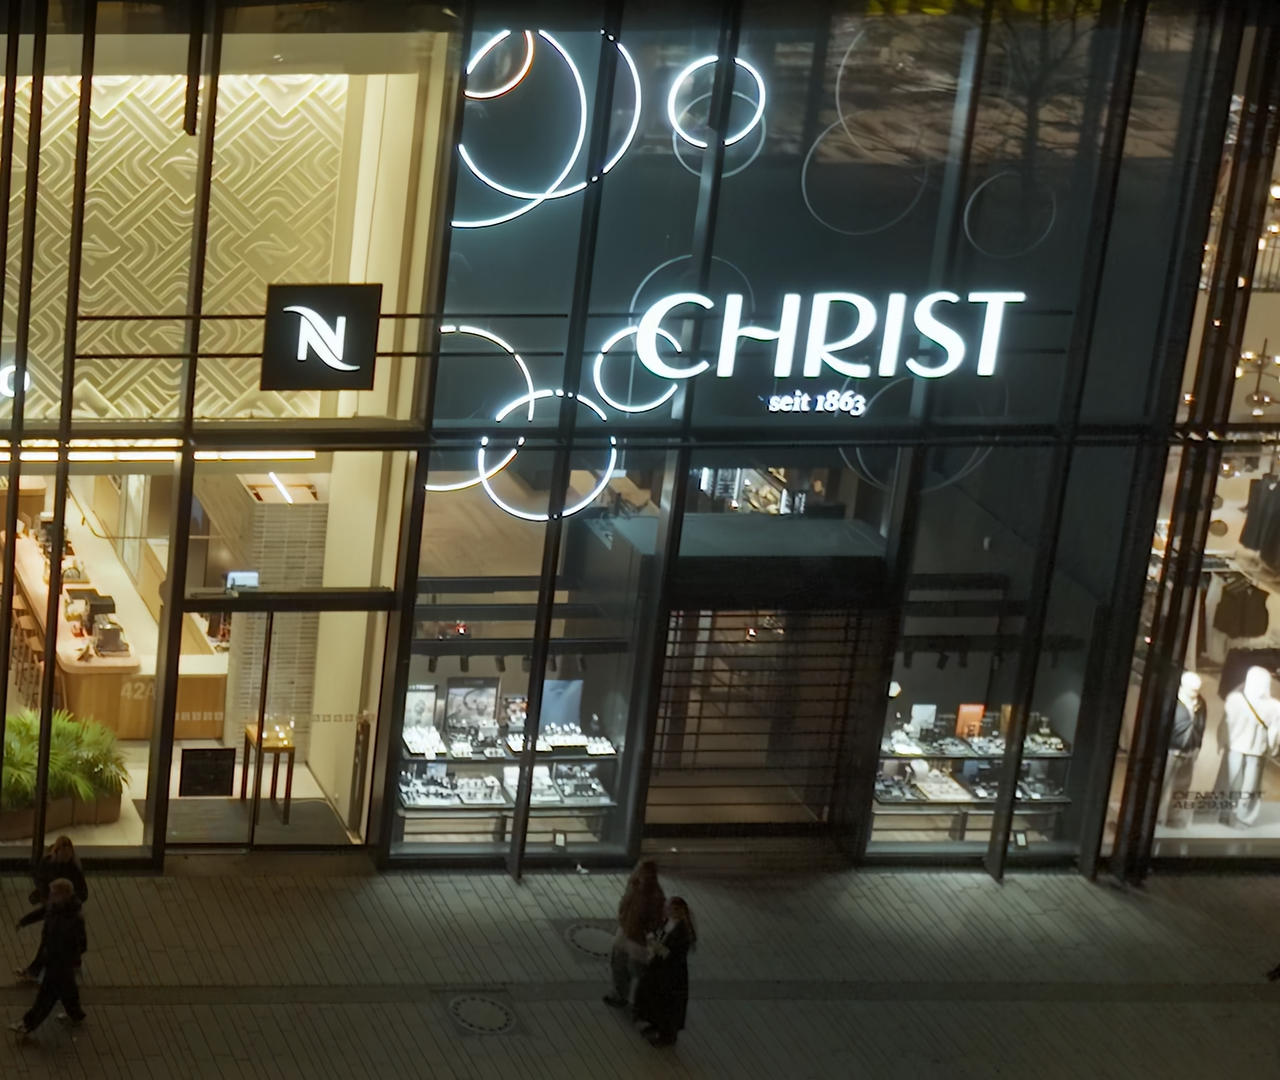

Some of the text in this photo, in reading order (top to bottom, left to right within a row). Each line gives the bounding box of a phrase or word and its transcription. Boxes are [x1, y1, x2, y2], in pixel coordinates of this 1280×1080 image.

[283, 306, 360, 370] N
[637, 292, 1026, 379] CHRIST
[768, 390, 866, 416] seit 1863
